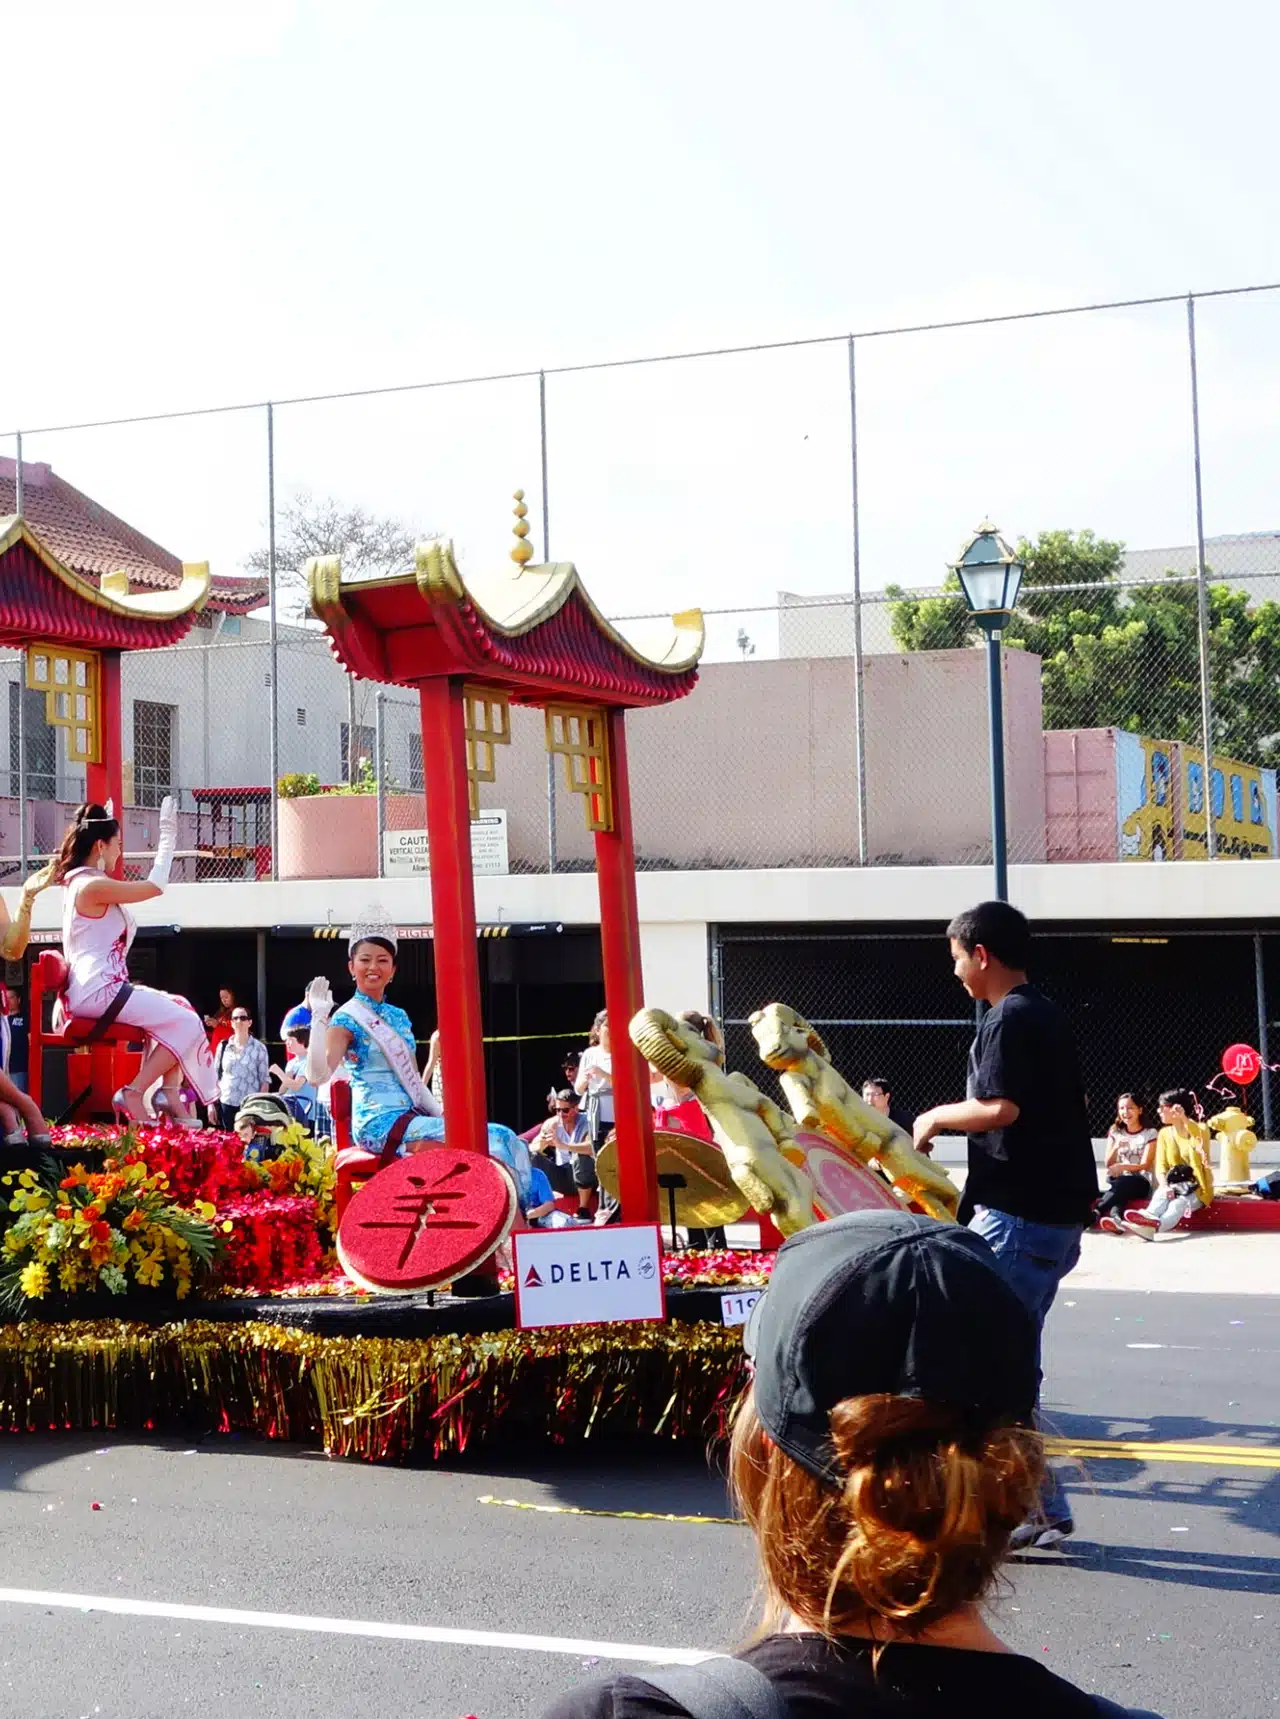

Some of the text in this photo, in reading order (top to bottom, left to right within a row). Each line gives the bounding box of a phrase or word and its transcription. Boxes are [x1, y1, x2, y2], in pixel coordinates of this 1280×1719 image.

[399, 836, 429, 846] CAUTI
[389, 847, 414, 855] VERTICAL
[398, 929, 431, 939] EIGH
[358, 1162, 481, 1270] 羊
[550, 1259, 631, 1284] DELTA
